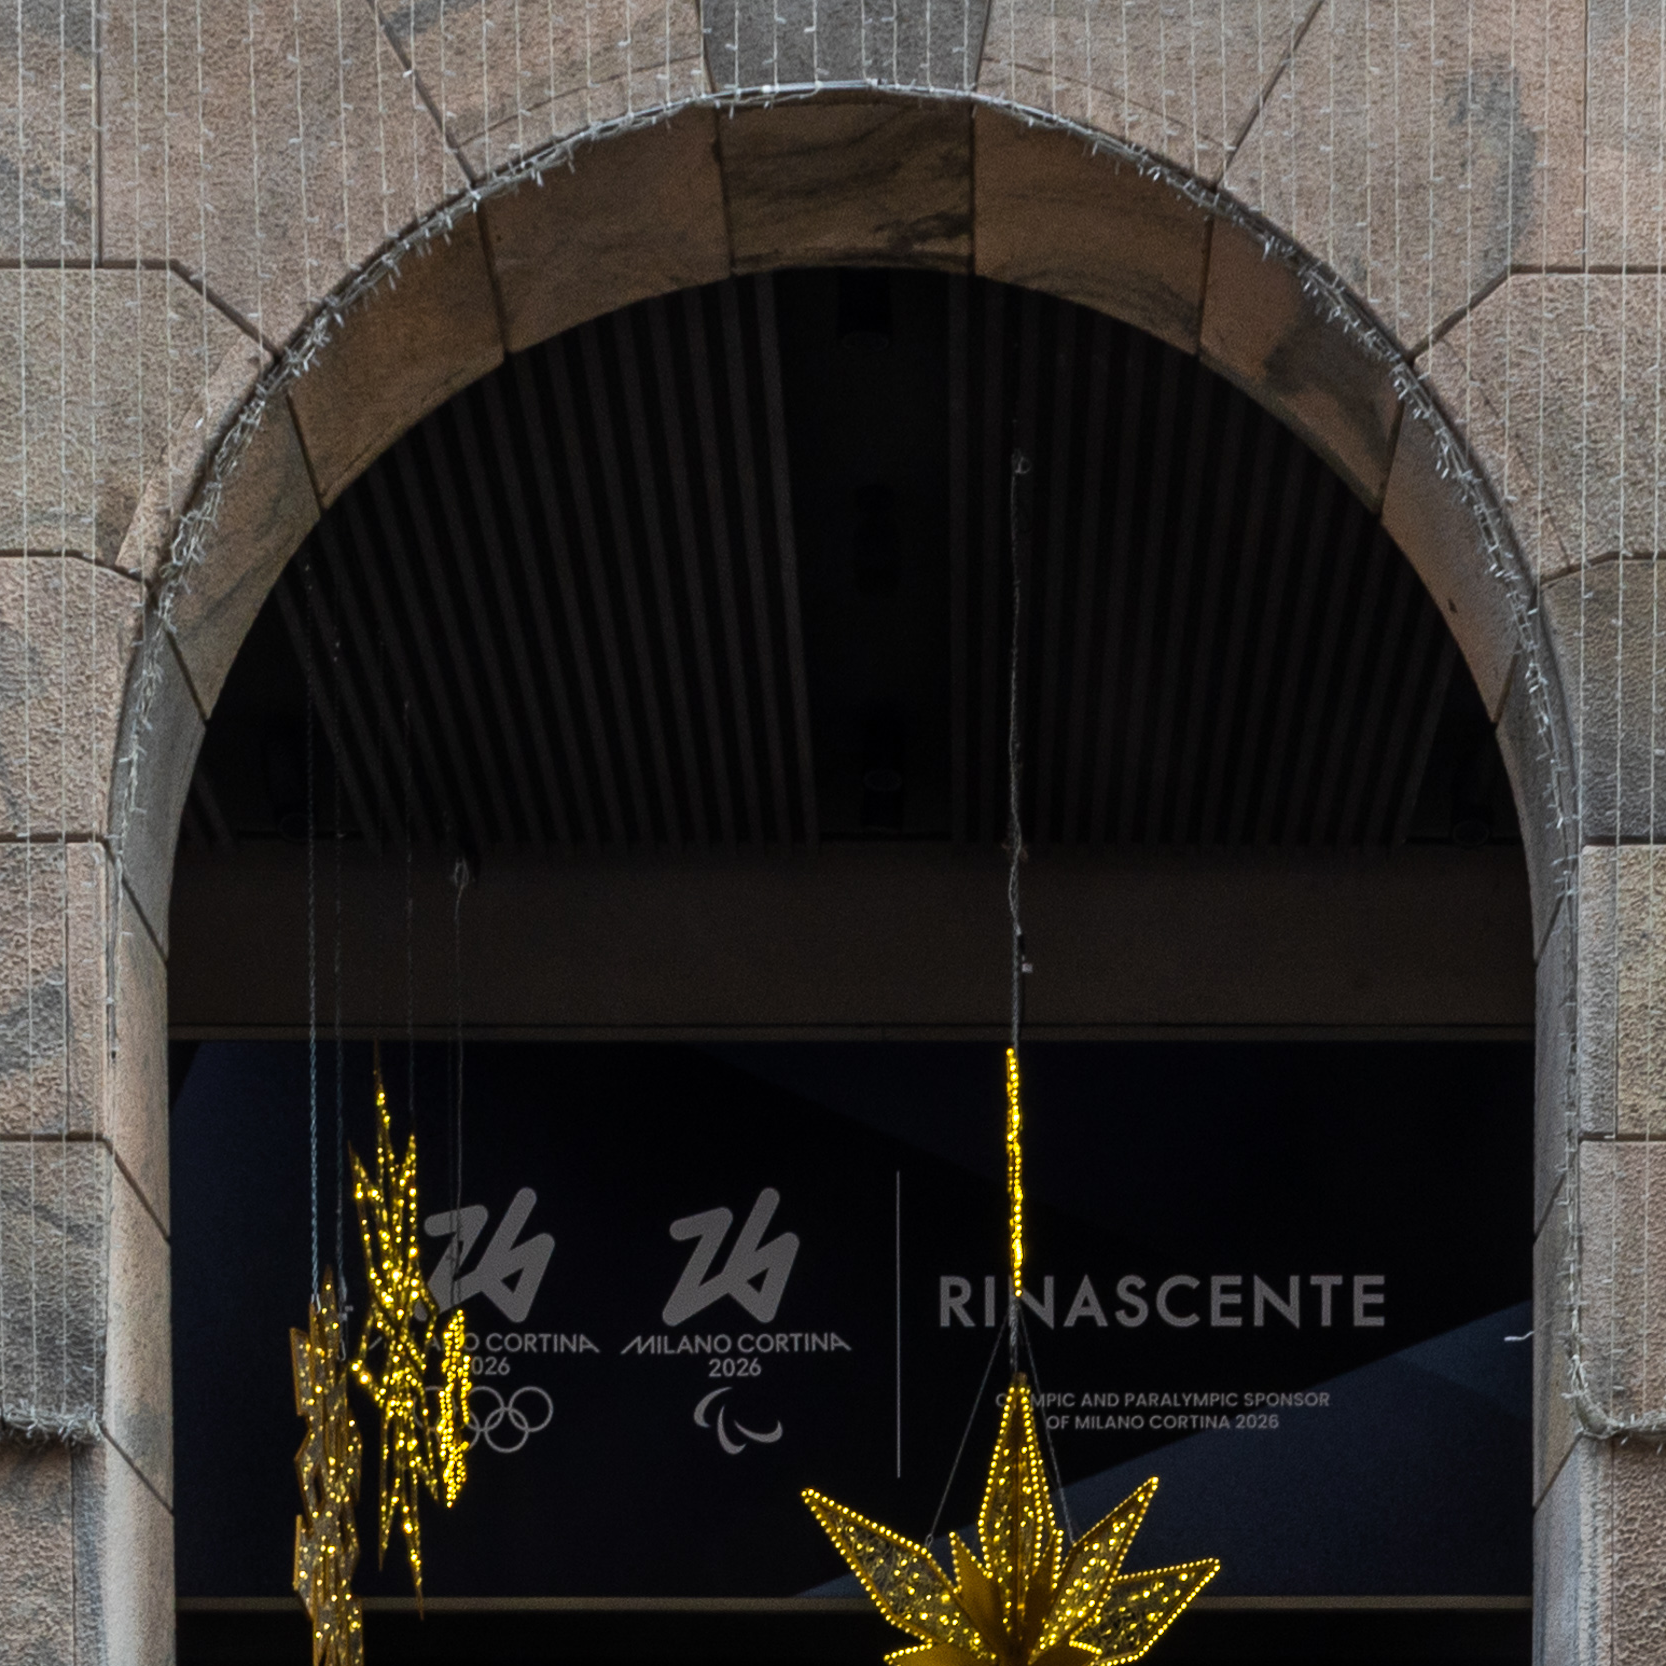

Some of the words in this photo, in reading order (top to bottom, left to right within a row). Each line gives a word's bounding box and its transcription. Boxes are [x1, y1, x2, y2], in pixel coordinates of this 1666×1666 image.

[939, 1274, 1386, 1330] RINASCENTE
[486, 1333, 600, 1353] CORTINA
[621, 1334, 732, 1354] MILANO
[737, 1332, 852, 1353] CORTINA
[466, 1356, 511, 1376] 026
[708, 1357, 762, 1377] 2026
[995, 1392, 1076, 1408] OMPIC
[1080, 1392, 1120, 1408] AND
[1125, 1392, 1238, 1408] PARALYMPIC
[1244, 1391, 1330, 1408] SPONSOR
[1046, 1414, 1071, 1430] OF
[1075, 1414, 1144, 1430] MILANO
[1149, 1413, 1230, 1430] CORTINA
[1235, 1413, 1279, 1429] 2026
